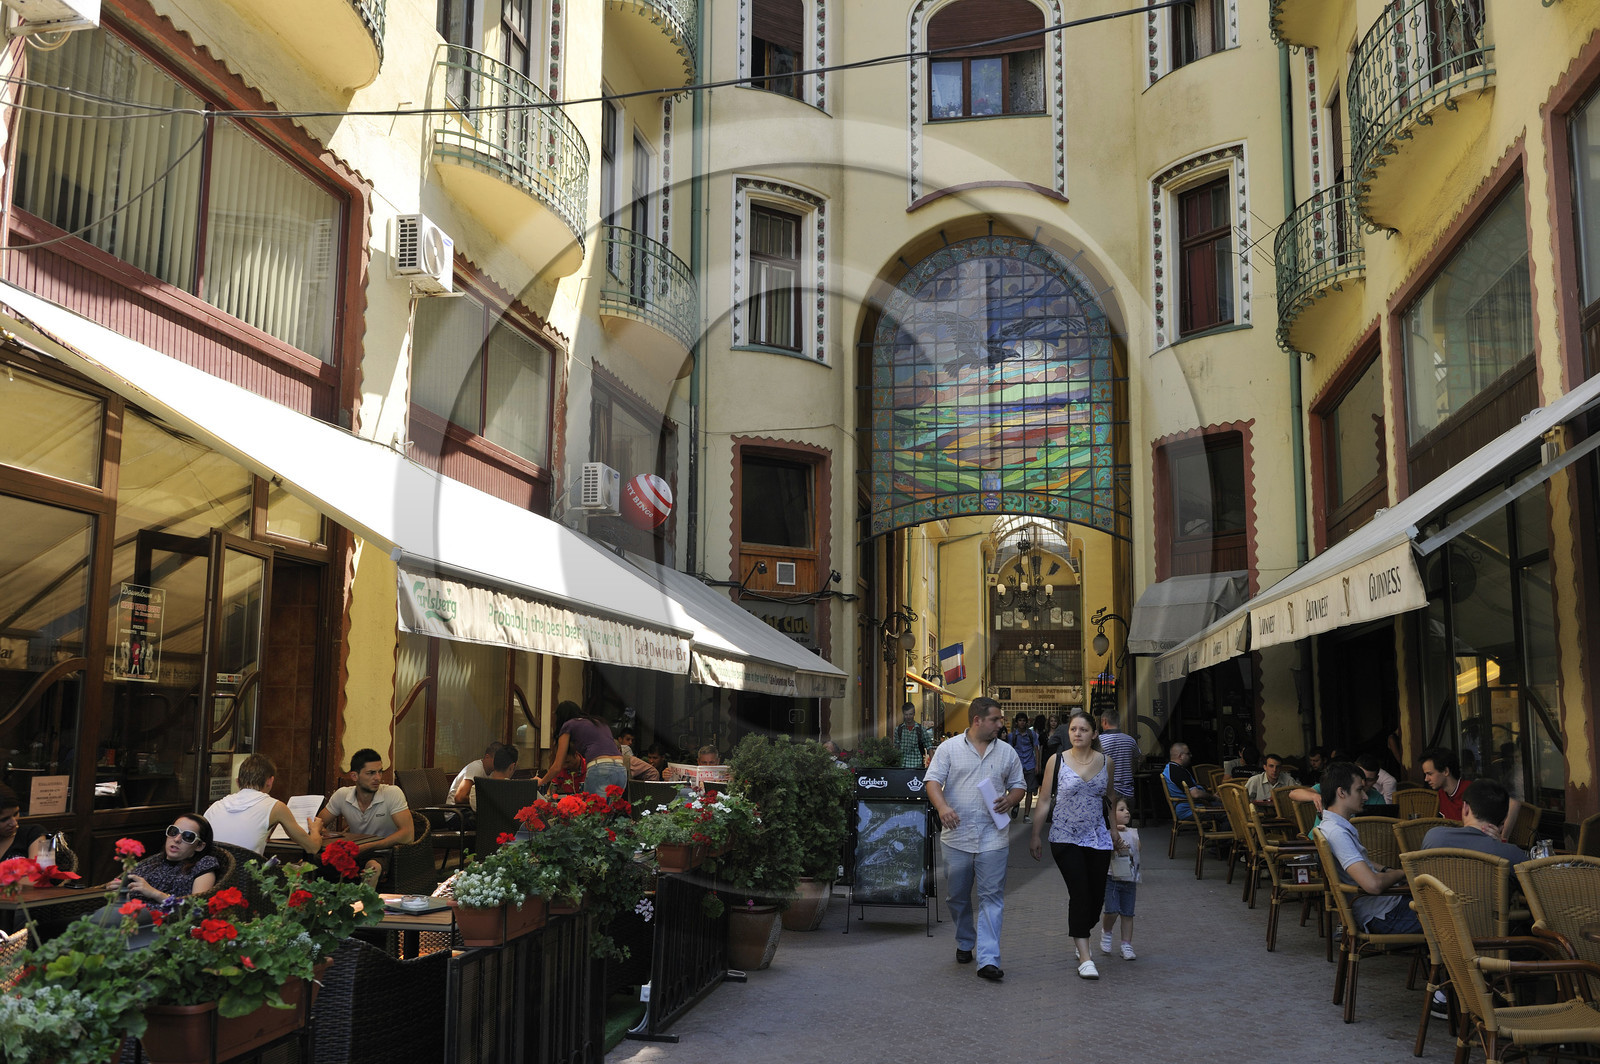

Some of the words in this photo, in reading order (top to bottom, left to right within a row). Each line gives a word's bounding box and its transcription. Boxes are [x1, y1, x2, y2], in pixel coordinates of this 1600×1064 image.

[632, 495, 654, 518] BINGO
[1368, 566, 1402, 602] GUINNESS
[413, 580, 457, 622] Carlsberg
[1305, 595, 1329, 623] GUINNESS
[488, 603, 528, 635] Probably
[783, 615, 811, 634] Club
[858, 776, 888, 789] Carlsberg
